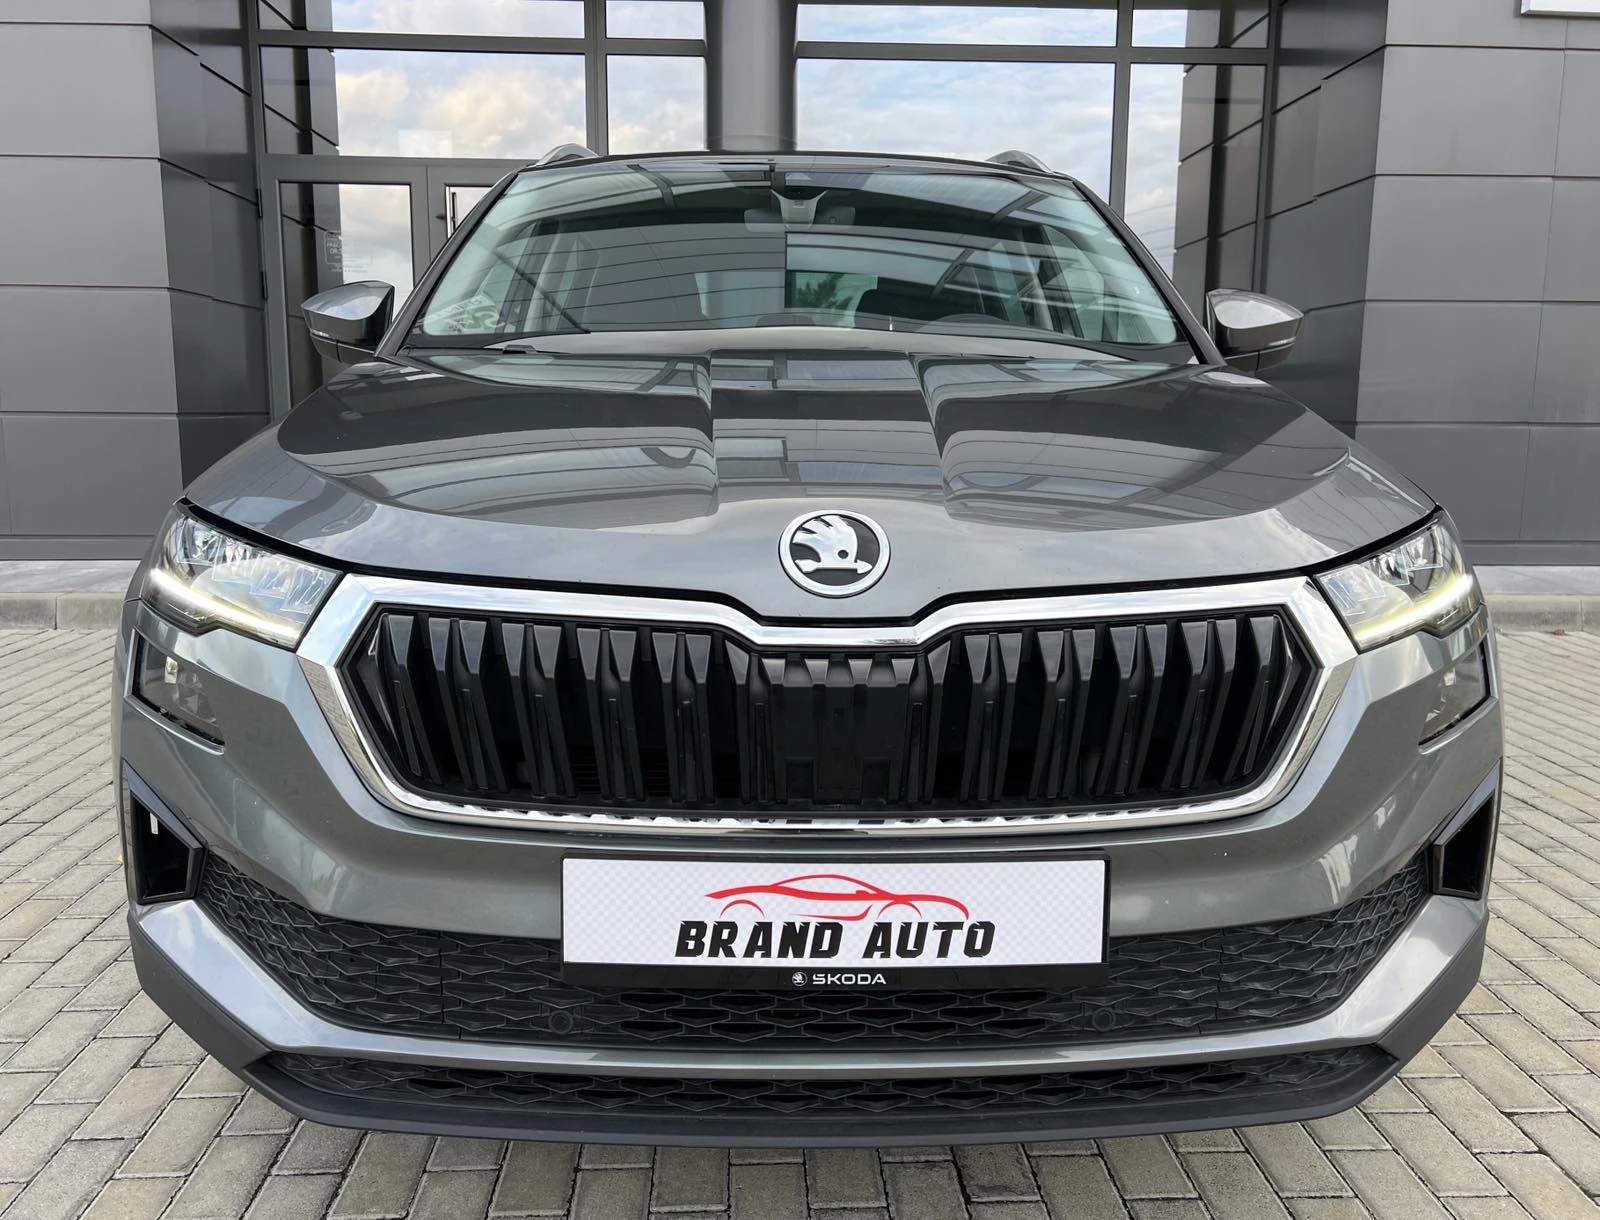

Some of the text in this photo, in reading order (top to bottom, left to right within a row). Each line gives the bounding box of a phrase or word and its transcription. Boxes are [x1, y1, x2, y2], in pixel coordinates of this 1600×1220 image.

[674, 920, 996, 959] BRAND AUTO
[812, 973, 887, 985] SKODA
